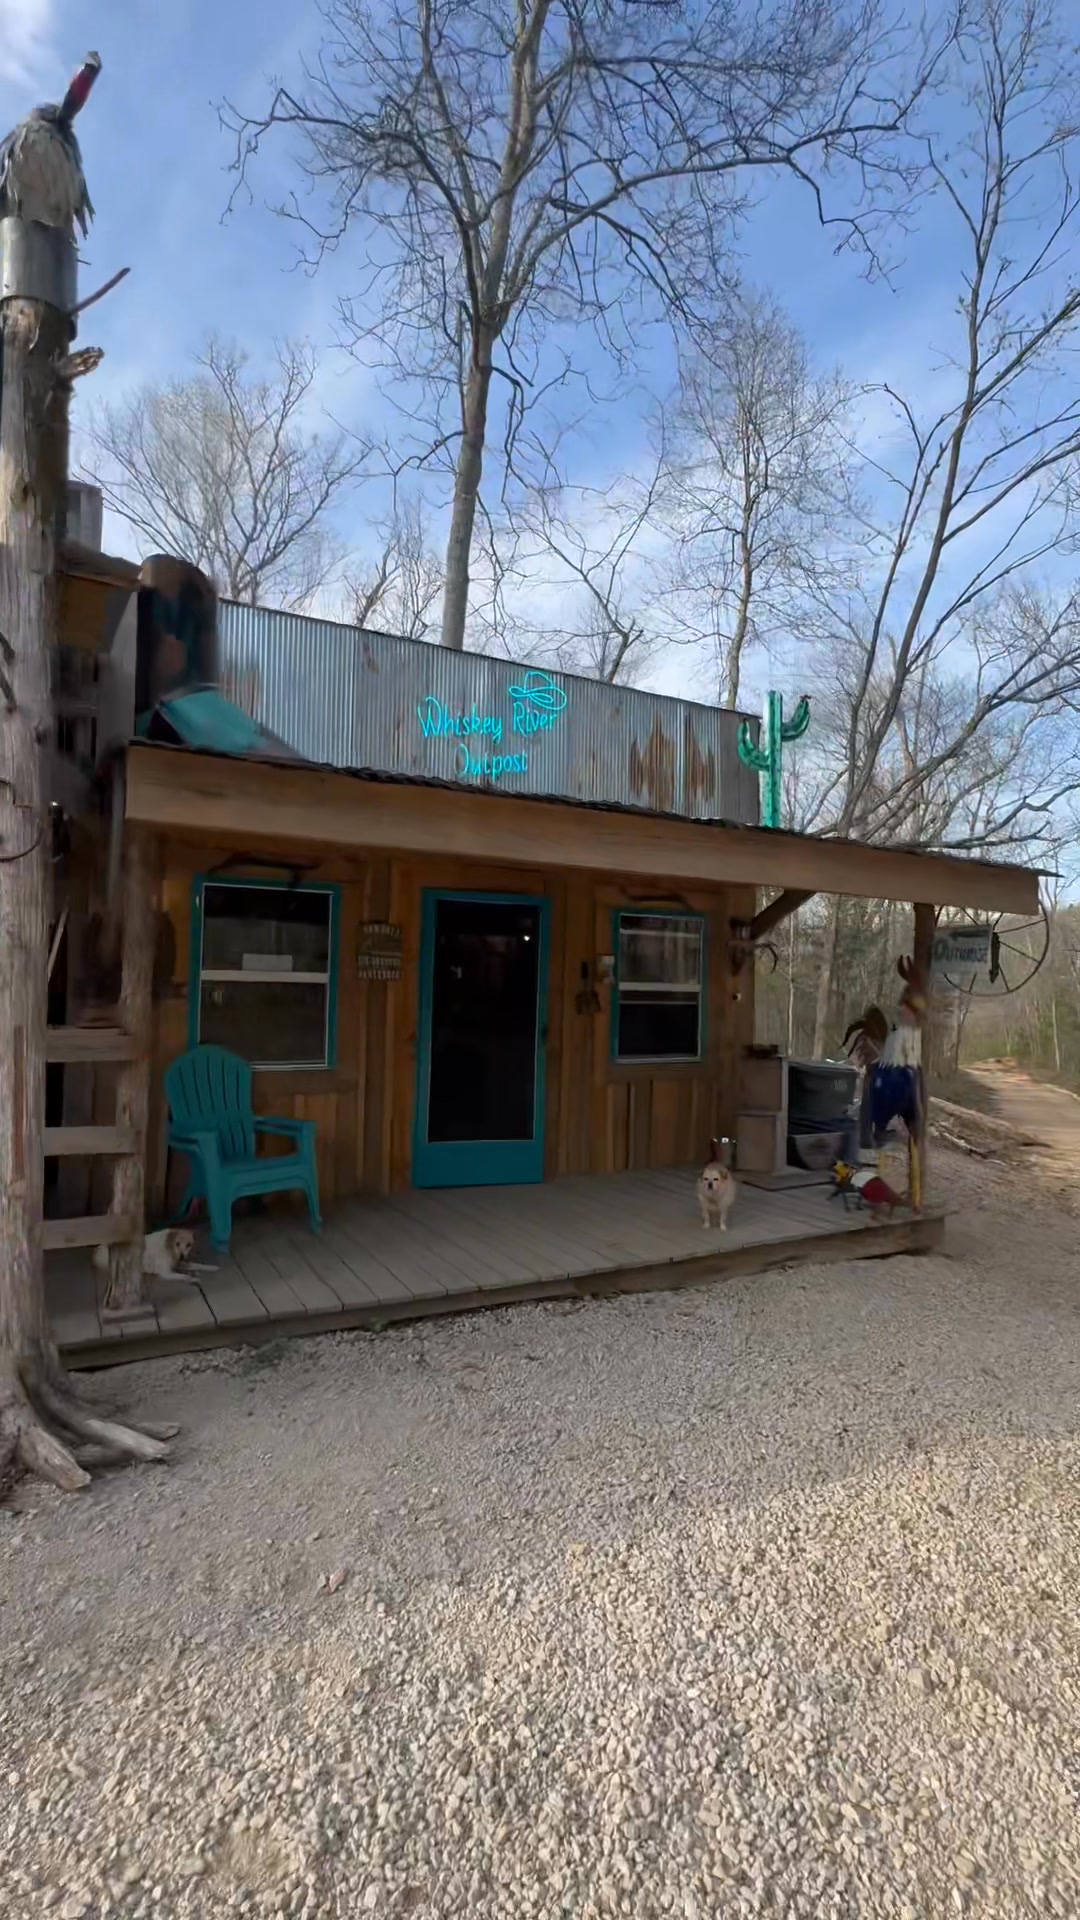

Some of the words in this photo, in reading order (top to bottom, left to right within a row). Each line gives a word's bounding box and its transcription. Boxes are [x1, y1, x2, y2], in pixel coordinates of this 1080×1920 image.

[417, 697, 502, 743] Whiskey
[513, 701, 557, 737] River
[455, 743, 528, 782] Outpost
